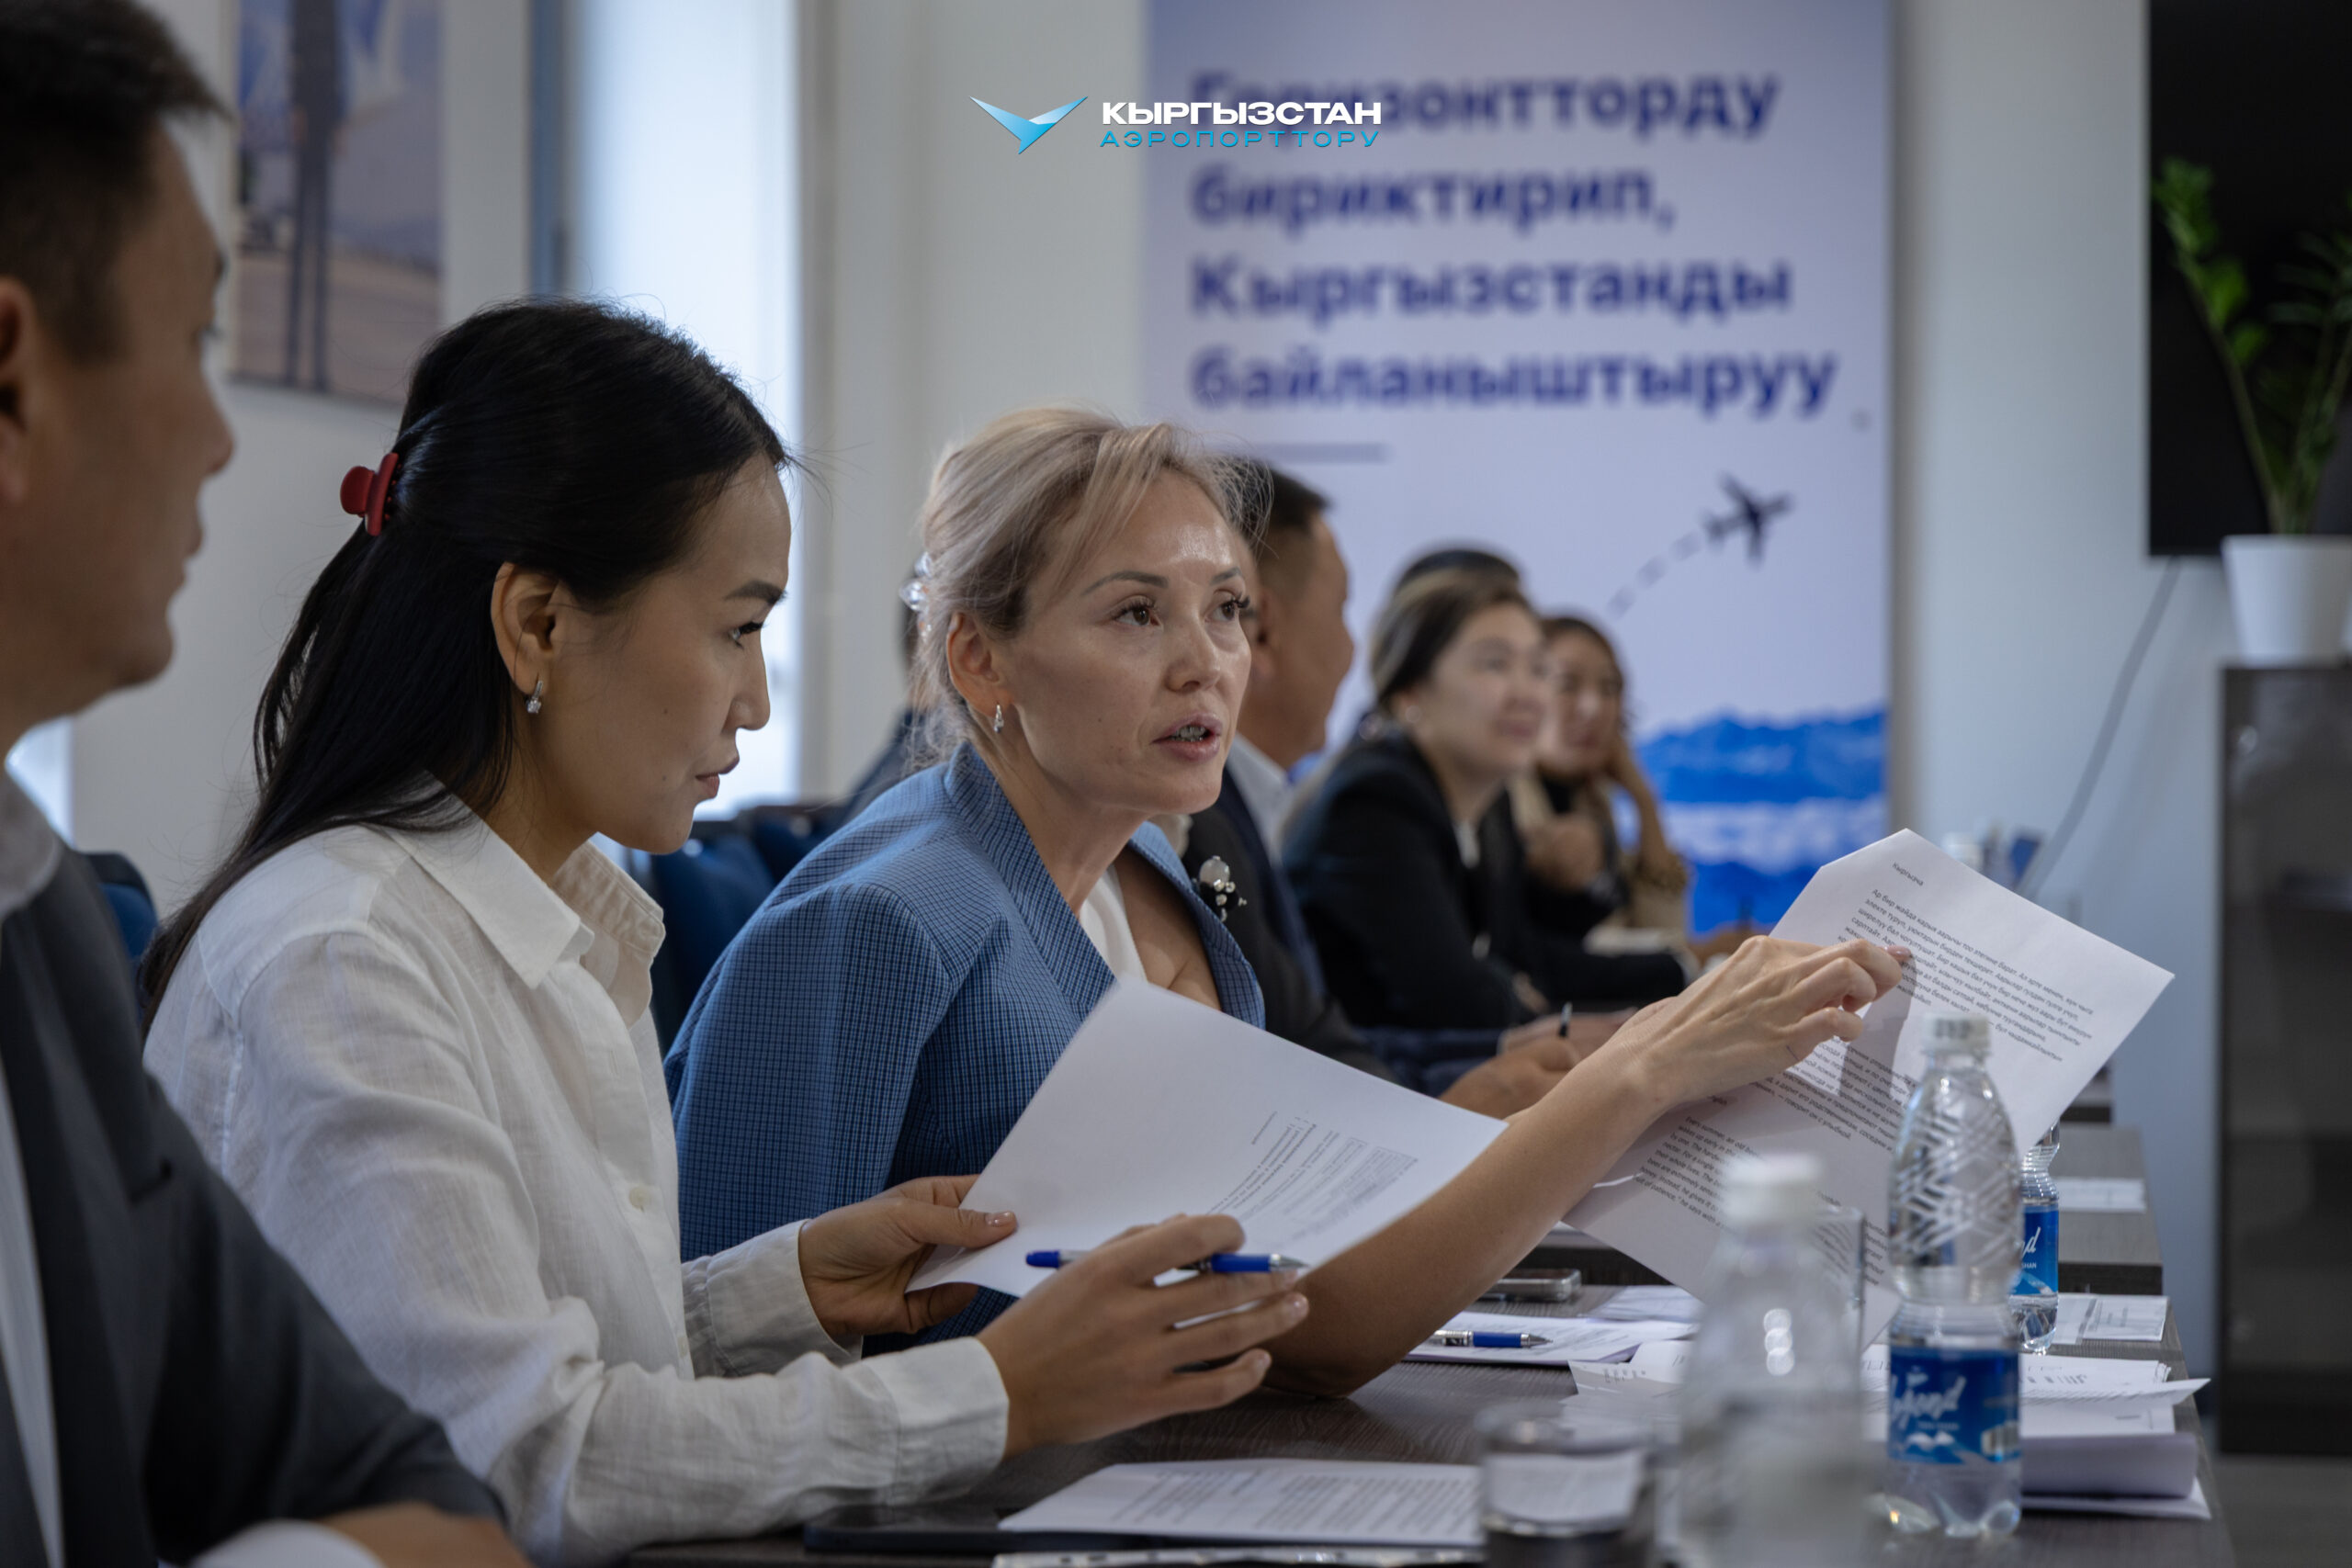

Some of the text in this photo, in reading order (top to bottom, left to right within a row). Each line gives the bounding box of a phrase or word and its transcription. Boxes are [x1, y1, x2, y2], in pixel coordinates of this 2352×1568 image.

[1193, 72, 1781, 144] Гзонтторду
[1193, 165, 1675, 237] бириктирип,
[1193, 256, 1792, 329] Кыргызстанды
[1193, 347, 1839, 419] байланыштыруу
